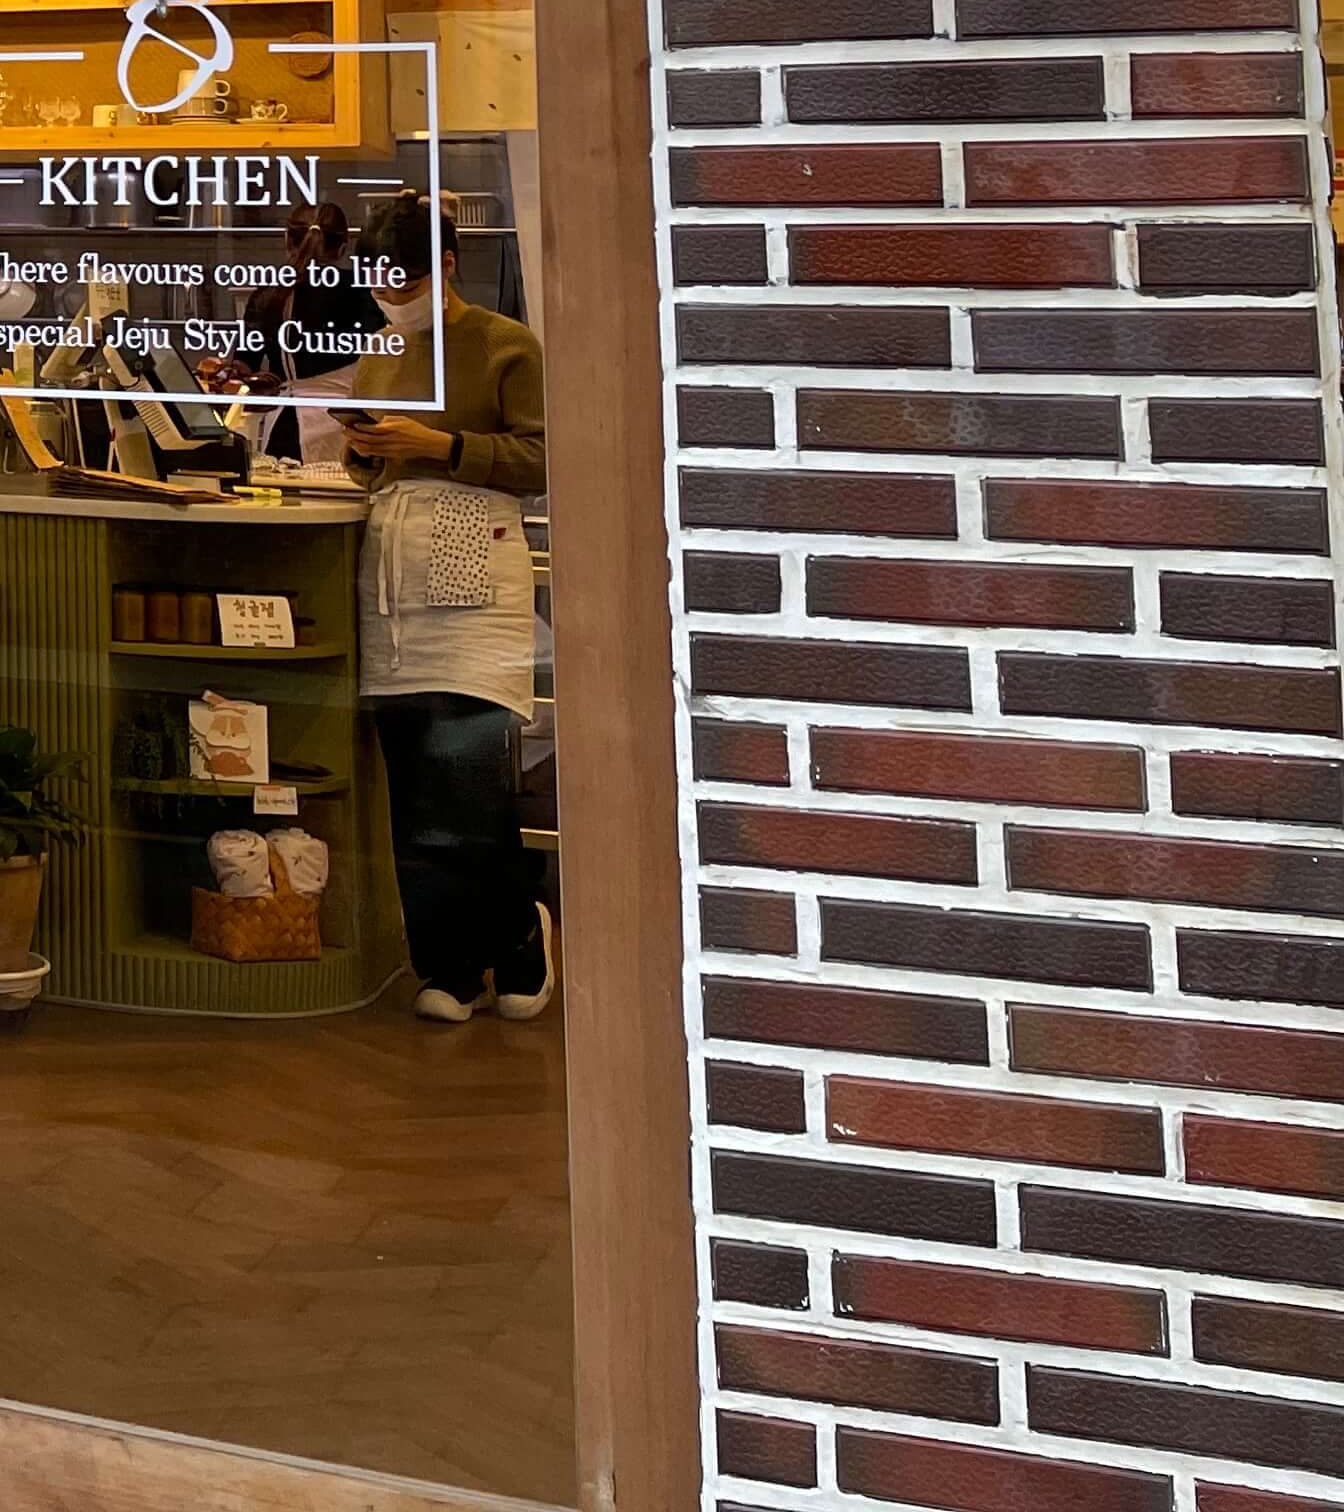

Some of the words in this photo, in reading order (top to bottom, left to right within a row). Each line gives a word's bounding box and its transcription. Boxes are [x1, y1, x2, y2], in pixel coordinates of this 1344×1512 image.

[38, 155, 321, 207] KITCHEN
[76, 252, 204, 286] flavours
[214, 260, 297, 287] come
[308, 258, 340, 288] to
[351, 256, 407, 289] life
[107, 316, 172, 352] Jeju
[184, 318, 265, 357] Style
[277, 320, 406, 356] Cuisine
